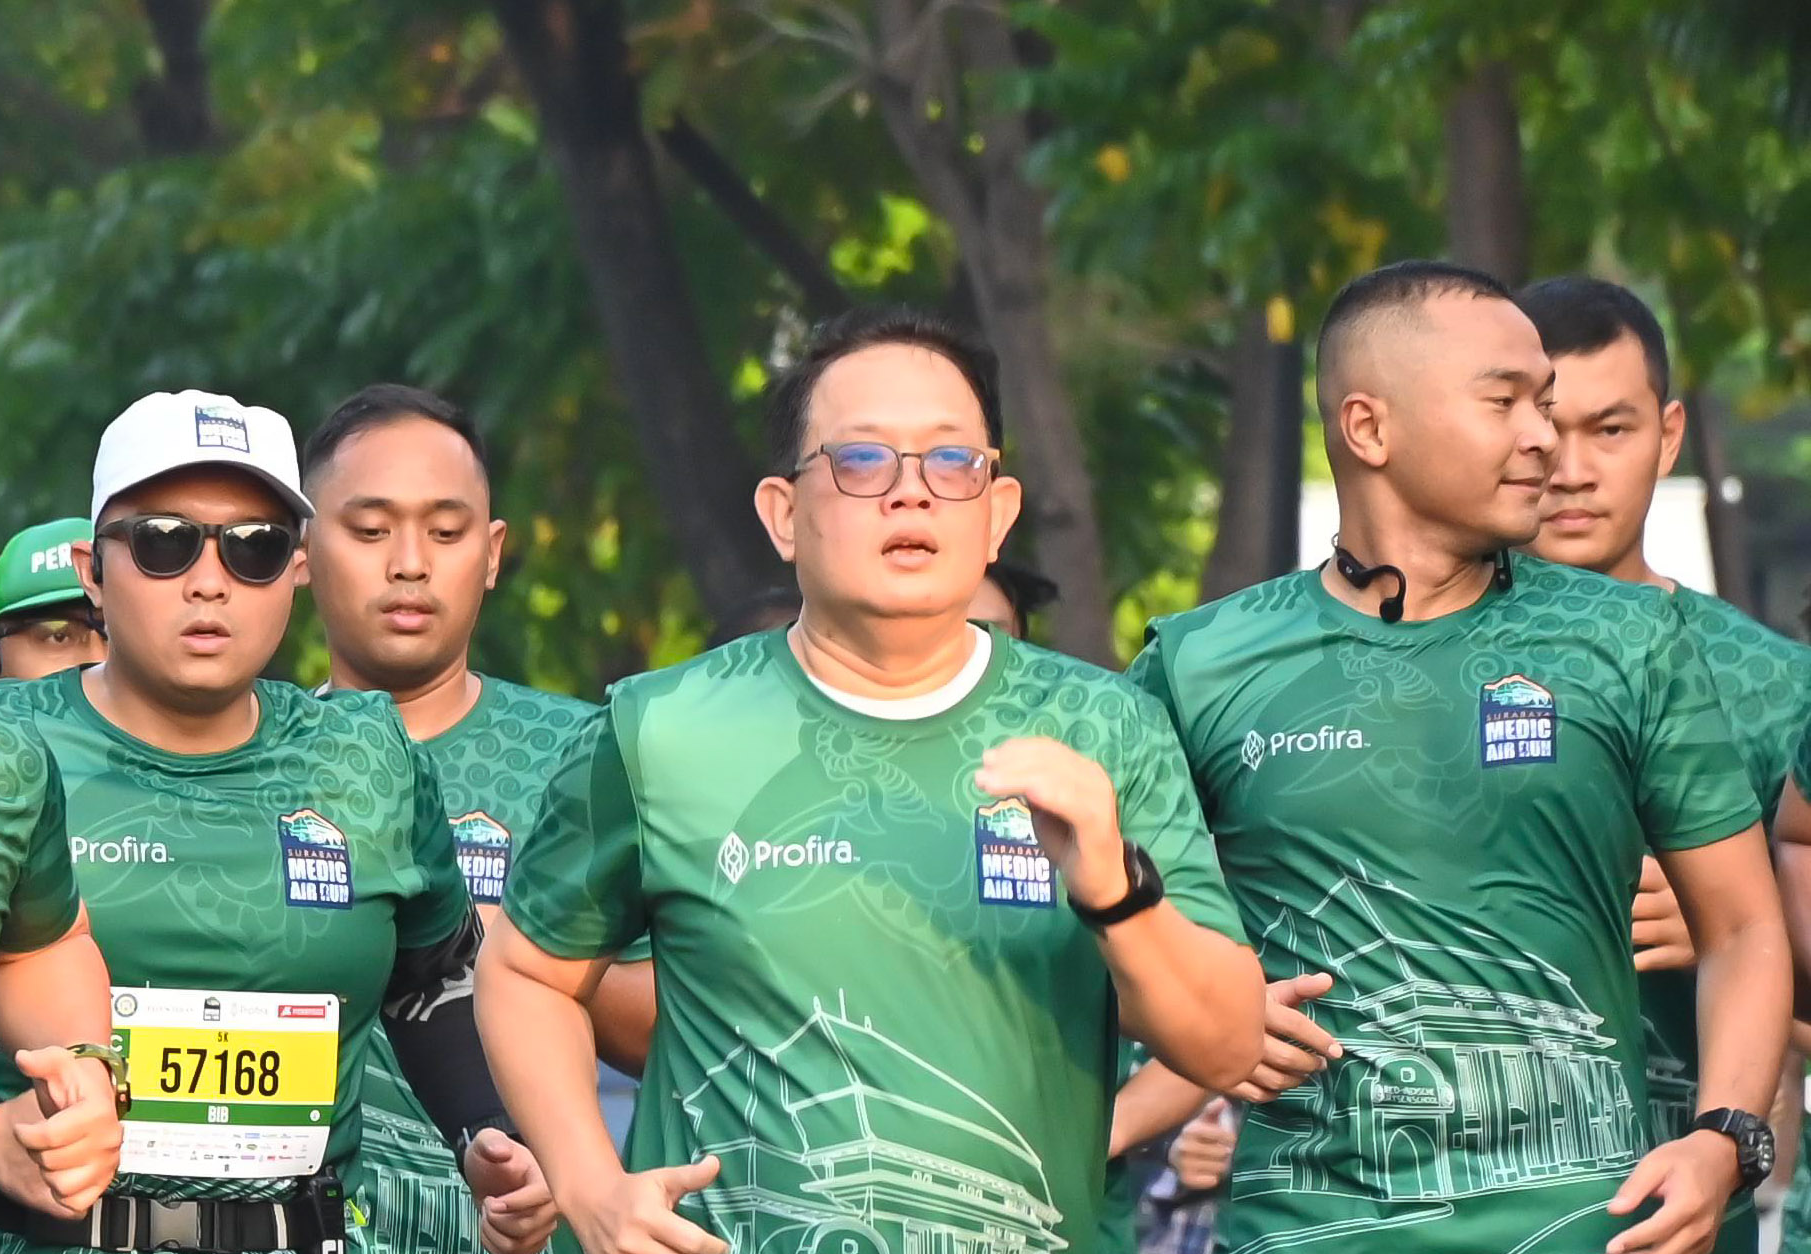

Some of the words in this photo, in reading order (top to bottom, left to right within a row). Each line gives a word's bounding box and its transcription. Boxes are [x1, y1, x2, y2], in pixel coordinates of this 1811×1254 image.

[1270, 725, 1364, 756] Profira
[1485, 718, 1551, 743] MEDIC
[1486, 742, 1515, 761] AIR
[71, 835, 167, 864] Profira
[754, 835, 853, 870] Profira
[288, 857, 347, 883] MEDIC
[982, 854, 1050, 881] MEDIC
[290, 880, 317, 901] AIR
[983, 878, 1013, 900] AIR
[160, 1047, 281, 1097] 57168
[208, 1105, 229, 1123] BIB
